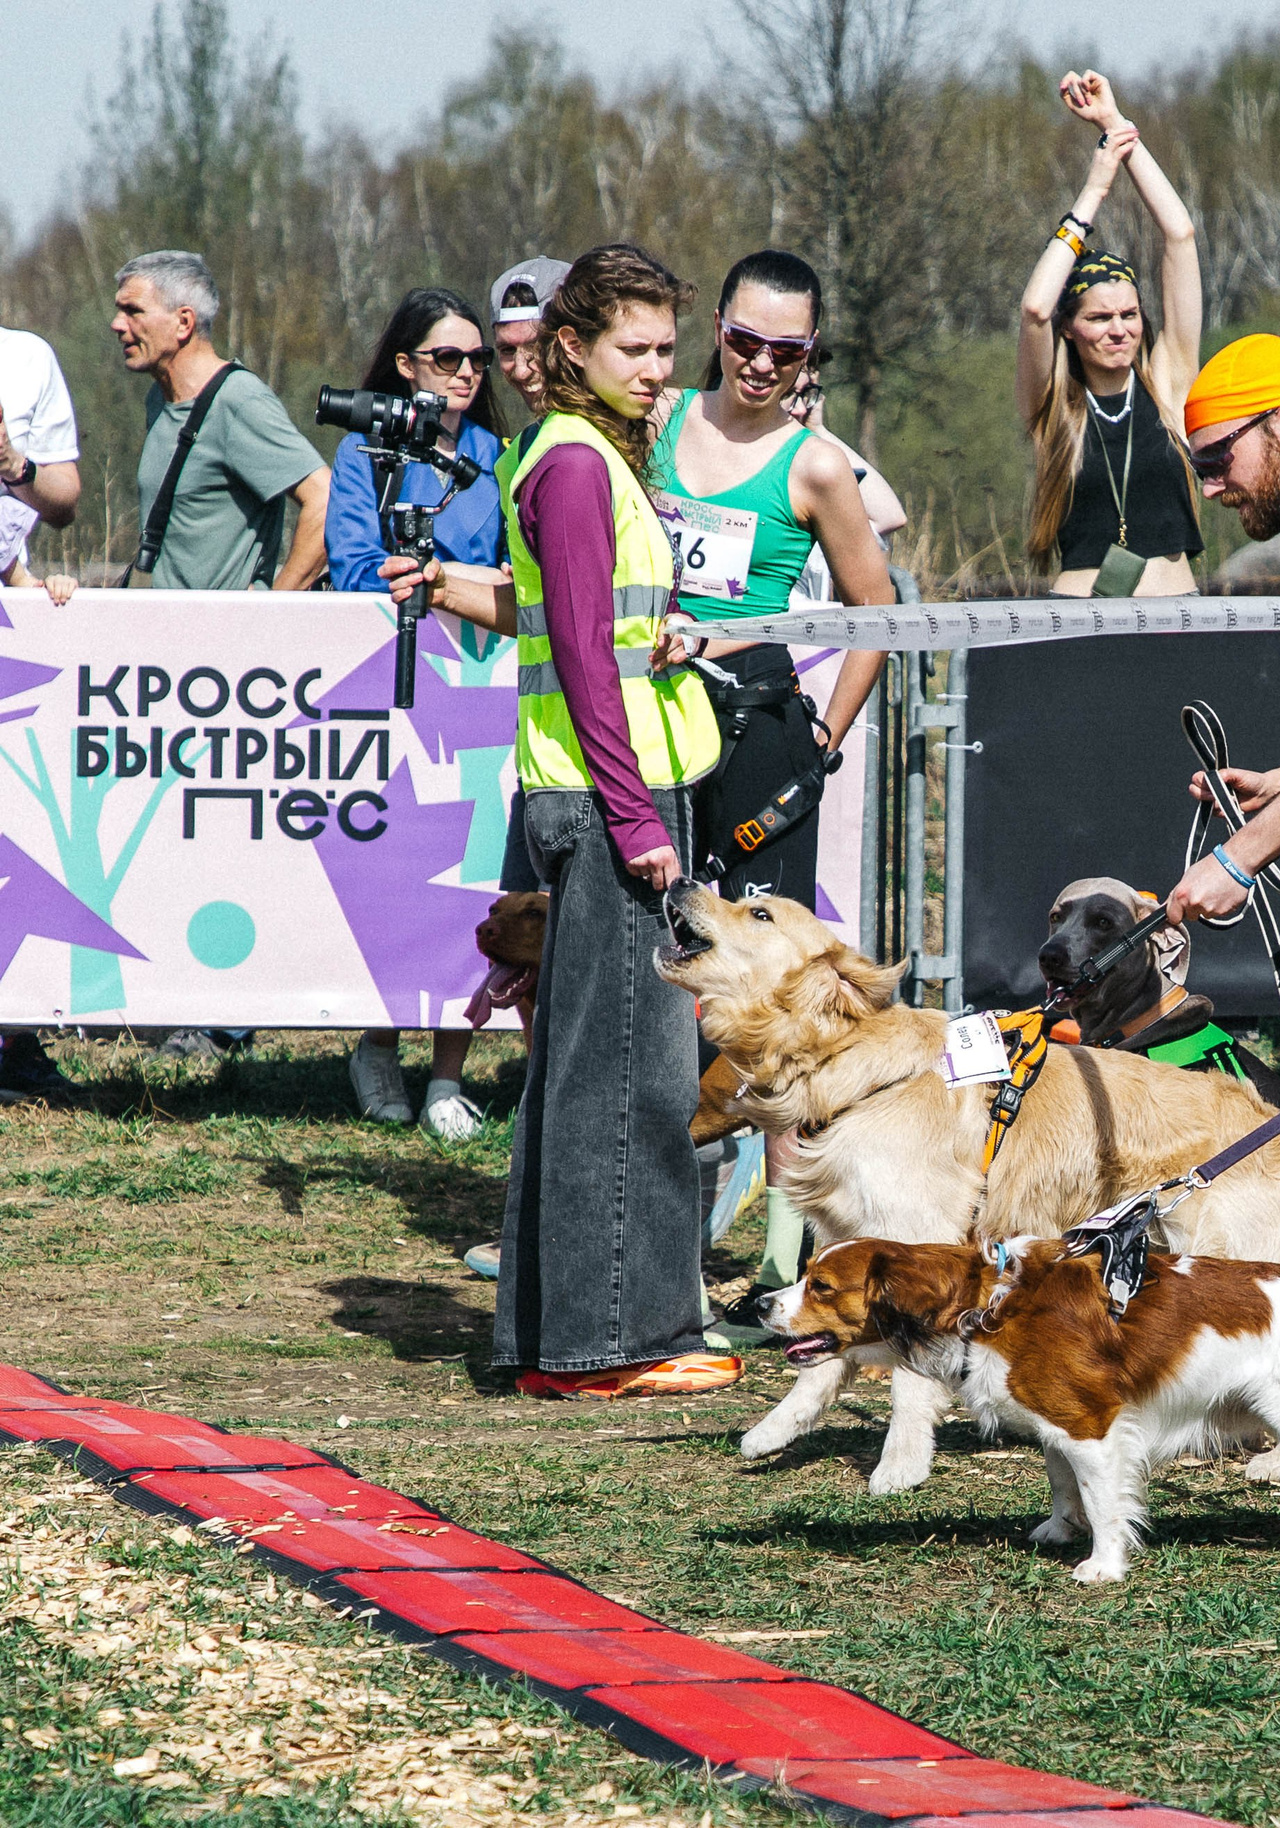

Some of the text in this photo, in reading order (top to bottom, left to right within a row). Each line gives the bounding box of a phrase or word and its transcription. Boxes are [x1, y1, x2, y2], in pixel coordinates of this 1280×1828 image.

[725, 518, 732, 526] 2
[78, 665, 322, 720] КРОСС
[76, 710, 390, 781] БЫСТРЫЙ
